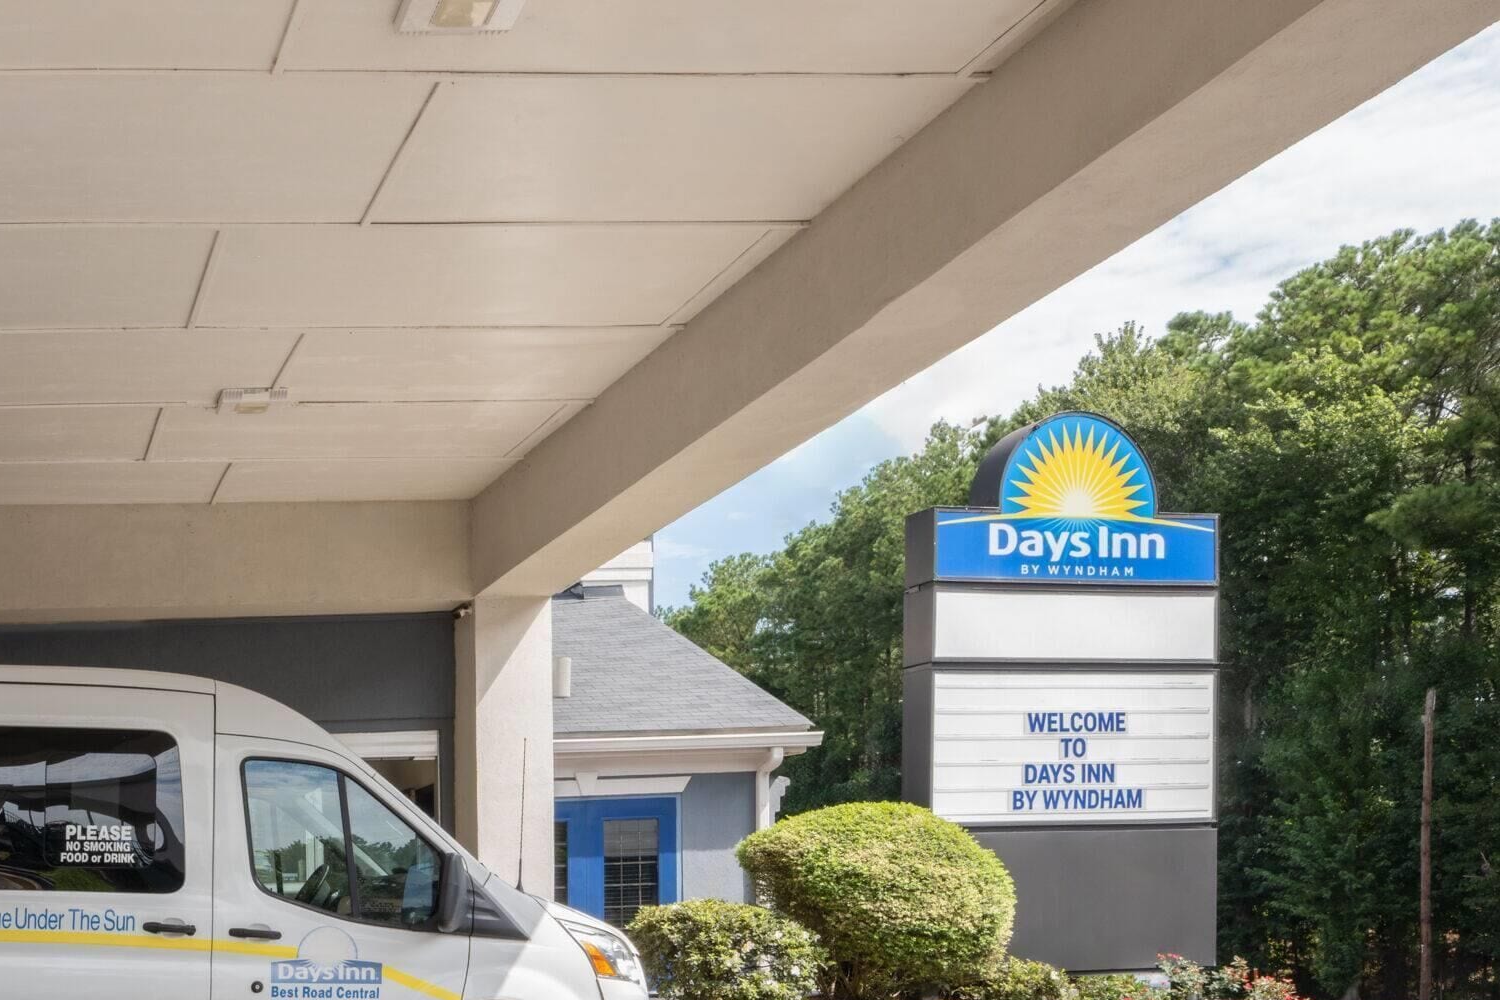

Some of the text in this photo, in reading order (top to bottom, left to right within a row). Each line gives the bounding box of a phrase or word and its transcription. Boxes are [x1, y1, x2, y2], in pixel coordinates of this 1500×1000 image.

[988, 523, 1165, 562] Days Inn
[1021, 564, 1134, 577] BY WYNDHAM
[1027, 712, 1126, 732] WELCOME
[1060, 738, 1086, 758] TO
[1024, 764, 1115, 784] DAYS INN
[1012, 789, 1143, 809] BY WYNDHAM
[65, 824, 132, 841] PLEASE
[66, 841, 131, 852] NO SMOKING
[60, 852, 135, 864] FOOD or DRINK
[15, 907, 65, 930] Under
[68, 908, 100, 931] The
[103, 909, 135, 931] Sun
[278, 963, 376, 982] Days Inn
[271, 987, 380, 999] Best Road Central
